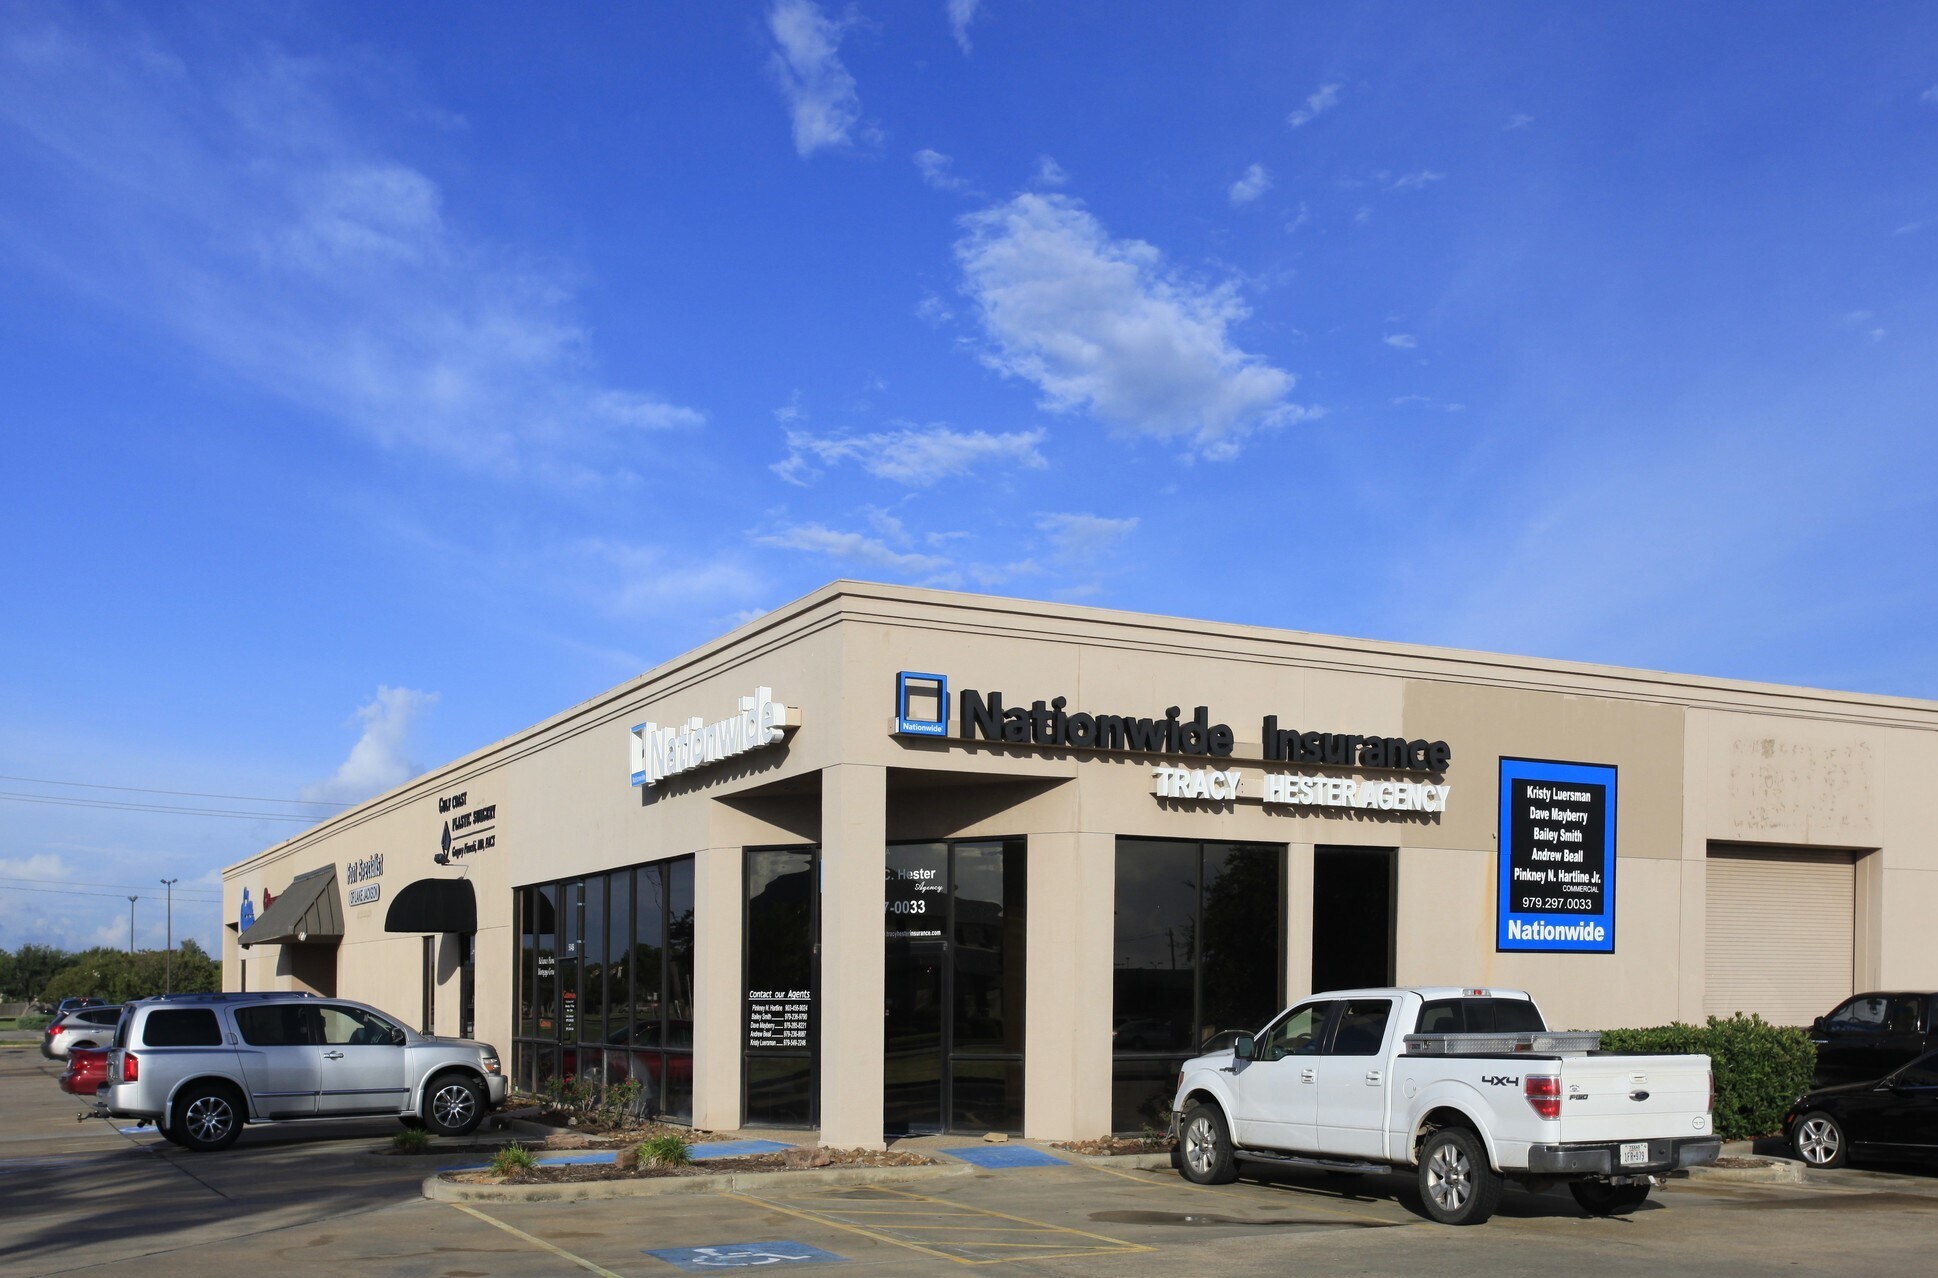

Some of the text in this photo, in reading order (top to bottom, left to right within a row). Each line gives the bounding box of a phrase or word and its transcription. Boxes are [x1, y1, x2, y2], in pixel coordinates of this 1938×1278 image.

[651, 686, 785, 780] Nationwide
[902, 722, 942, 733] Nationwide
[960, 688, 1451, 772] Nationwide Insurance
[1153, 767, 1451, 812] TRACY HESTER AGENCY
[1527, 785, 1591, 802] Kristy Luersman
[1530, 806, 1588, 825] Dave Mayberry
[1534, 827, 1582, 843] Bailey Smith
[1531, 847, 1583, 862] Andrew Beall
[898, 868, 936, 880] Hester
[1514, 867, 1601, 884] Pinkney N. Hartline Jr.
[914, 881, 944, 894] Agency
[1562, 885, 1599, 893] COMMERCIAL
[1522, 897, 1592, 910] 979.297.0033
[1508, 920, 1604, 941] Nationwide
[749, 990, 772, 998] Contact
[787, 990, 810, 999] Agents
[1481, 1075, 1519, 1087] 4X4
